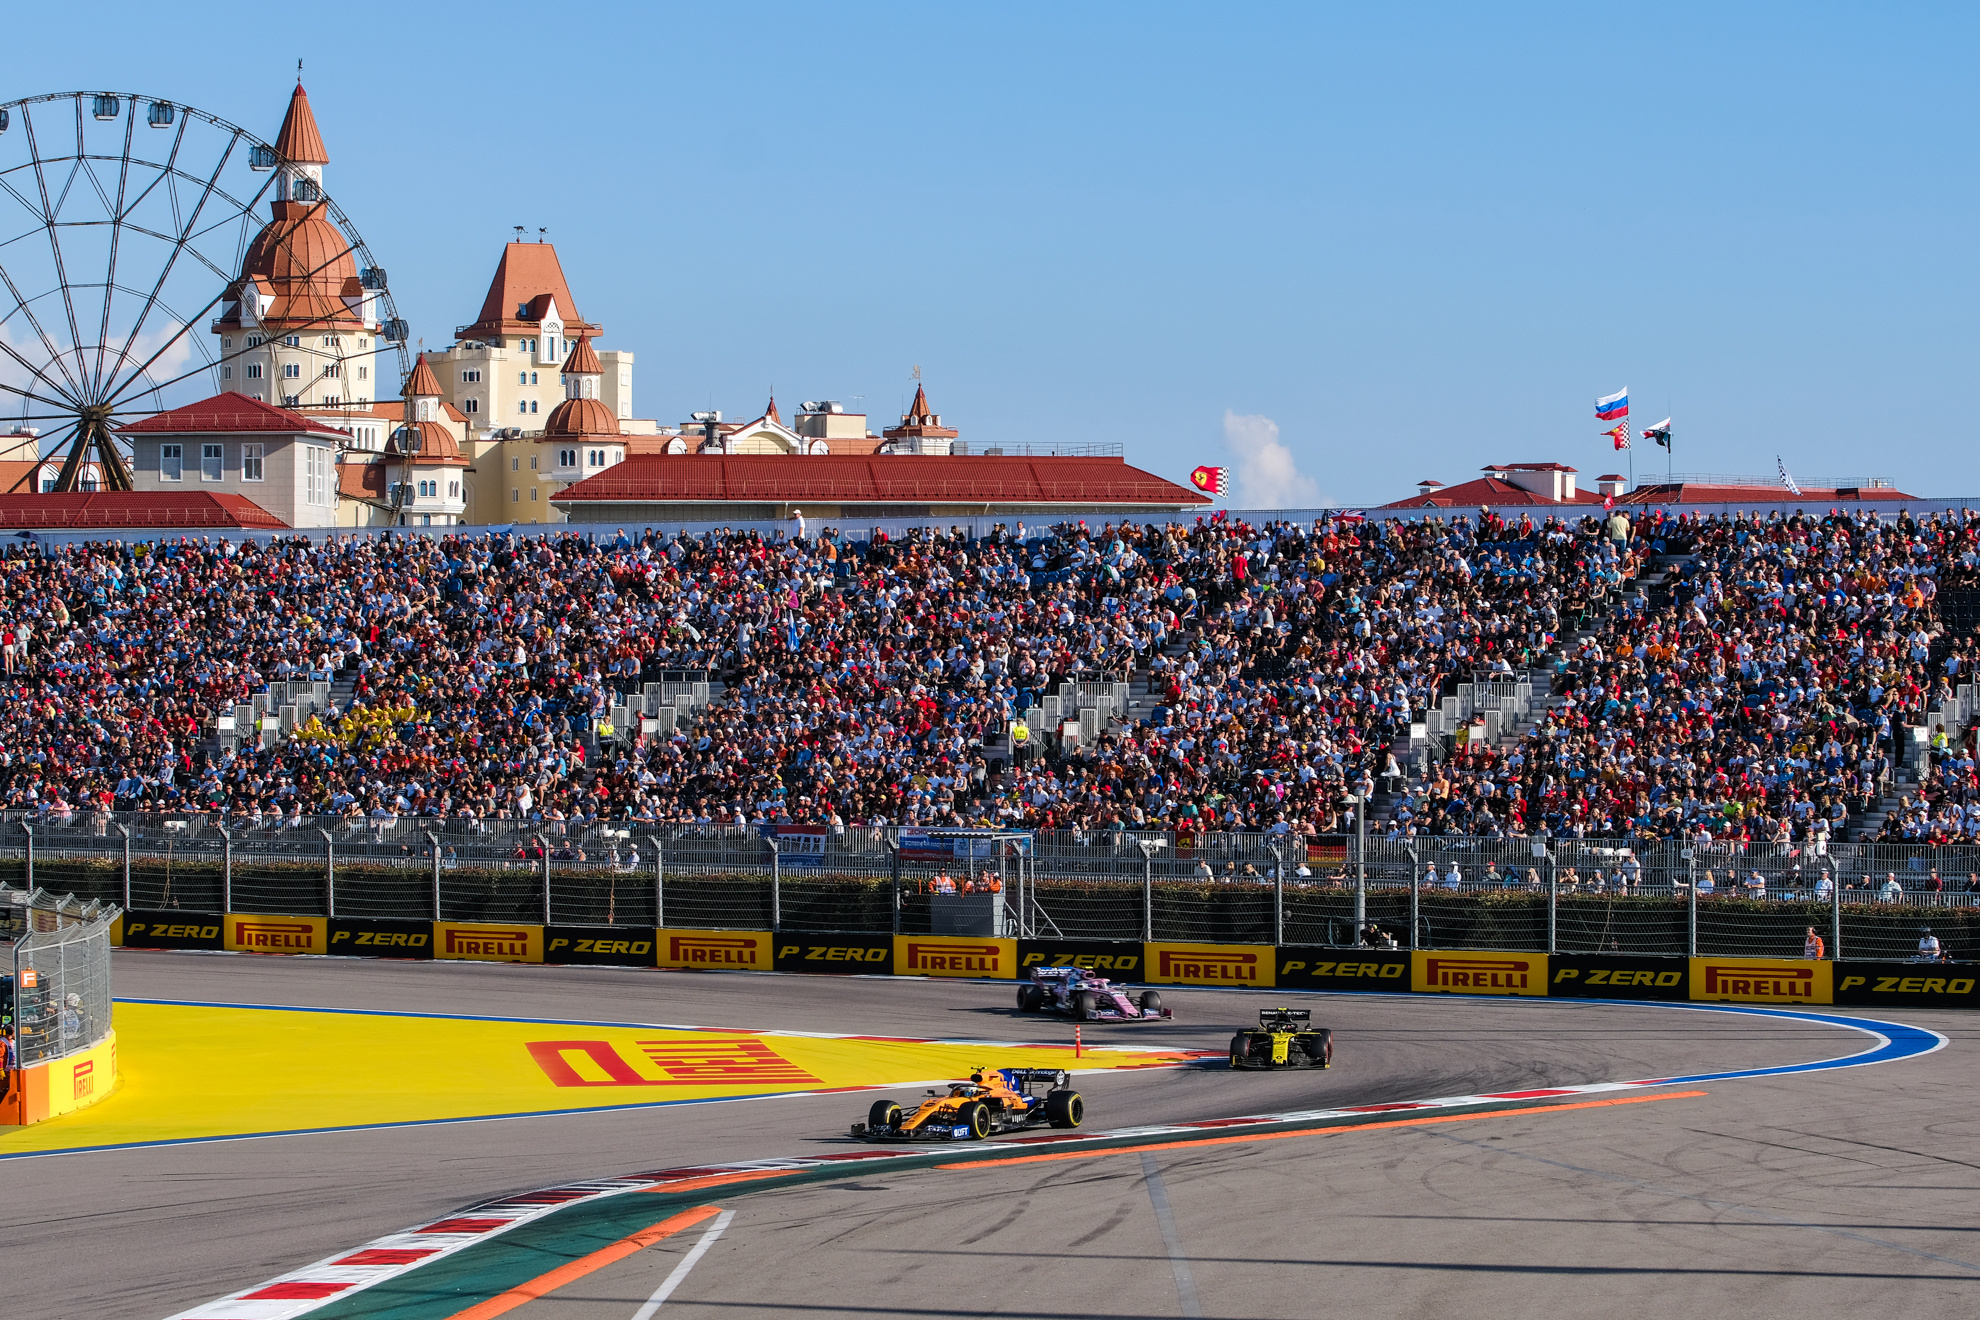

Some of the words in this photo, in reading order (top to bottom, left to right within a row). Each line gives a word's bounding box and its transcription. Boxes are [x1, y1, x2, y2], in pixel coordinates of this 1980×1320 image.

[127, 923, 146, 936] P
[149, 924, 222, 939] ZERO
[235, 921, 314, 949] PIRELLI
[331, 931, 351, 944] P
[354, 932, 428, 947] ZERO
[445, 929, 529, 956] PIRELLI
[548, 938, 569, 951] P
[573, 939, 652, 955] ZERO
[669, 936, 758, 964] PIRELLI
[778, 945, 800, 959] P
[804, 946, 888, 962] ZERO
[907, 943, 1000, 972] PIRELLI
[1022, 952, 1045, 967] P
[1050, 954, 1139, 970] ZERO
[1159, 950, 1258, 980] PIRELLI
[1281, 961, 1306, 975] P
[1311, 962, 1405, 978] ZERO
[1426, 958, 1530, 989] PIRELLI
[23, 972, 35, 986] F
[1553, 969, 1579, 983] P
[1584, 969, 1682, 987] ZERO
[1705, 966, 1814, 997] PIRELLI
[1839, 976, 1866, 991] P
[1872, 977, 1976, 994] ZERO
[73, 1059, 94, 1100] PIRELLI
